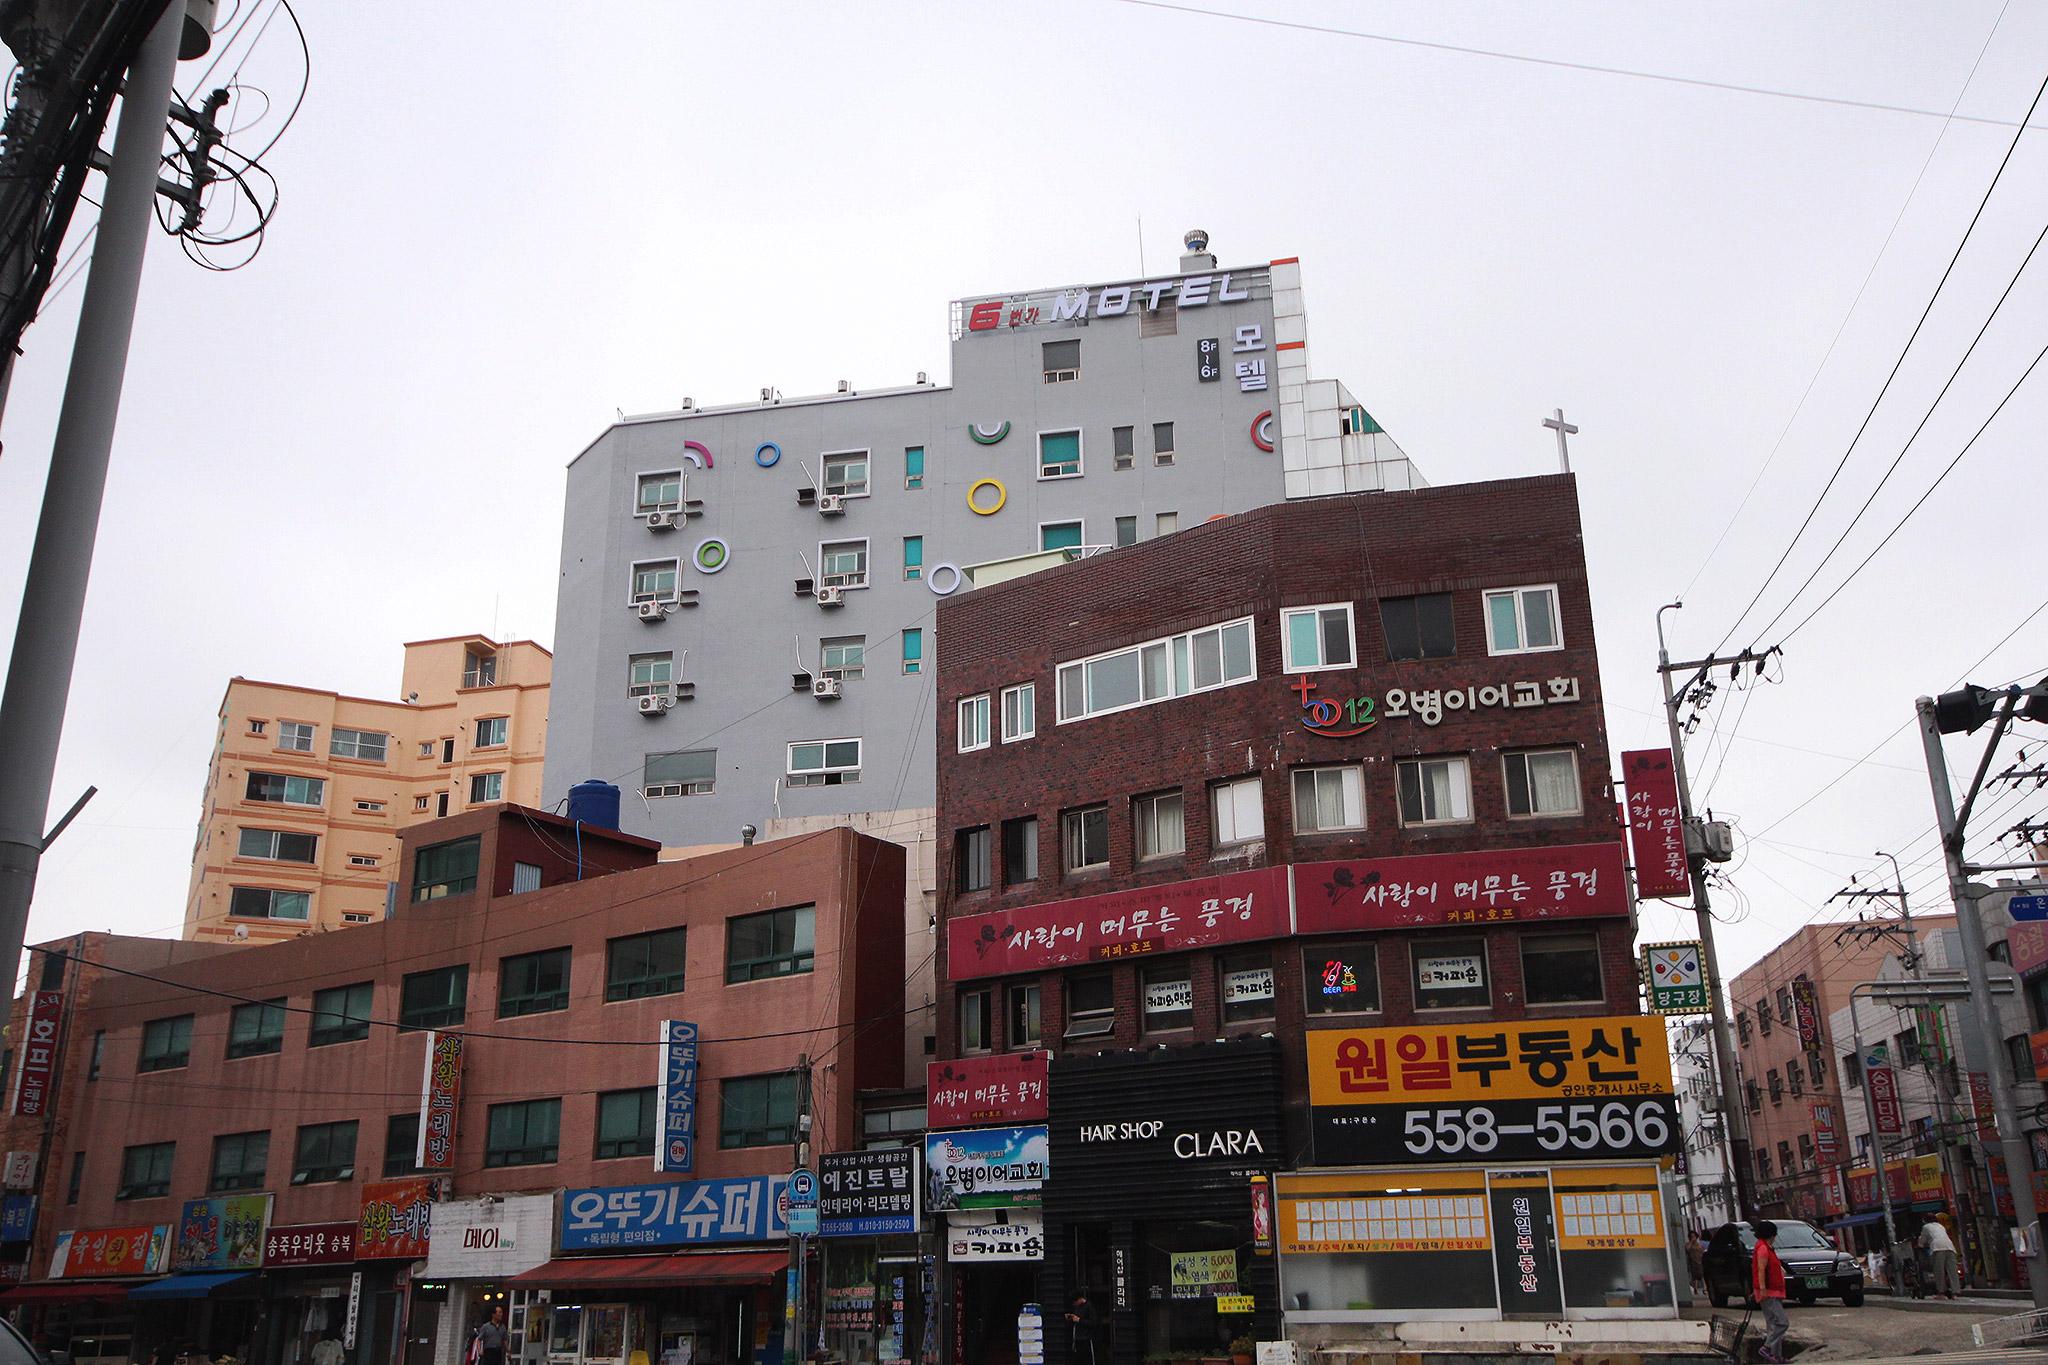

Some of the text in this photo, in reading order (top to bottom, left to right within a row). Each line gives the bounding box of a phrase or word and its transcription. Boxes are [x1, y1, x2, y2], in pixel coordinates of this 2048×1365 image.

[1050, 274, 1248, 322] MOTEL
[1200, 339, 1217, 353] 8F
[1233, 323, 1268, 392] 모텔
[1201, 365, 1218, 379] 6F
[1384, 676, 1581, 727] 오병이어교회
[1631, 791, 1652, 832] 사랑이
[1362, 867, 1598, 908] 사랑이 머무는 풍경
[1007, 921, 1085, 951] 사랑이
[1100, 905, 1181, 939] 머무는
[1197, 892, 1254, 929] 풍경
[1236, 978, 1273, 995] 커피숍
[1433, 966, 1478, 983] 커피숍
[1323, 986, 1341, 994] BEER
[1657, 990, 1702, 1008] 당구장
[27, 1018, 56, 1072] 호프
[1335, 1026, 1642, 1093] 원일부동산
[667, 1024, 696, 1132] 오뚜기슈퍼
[1561, 1081, 1664, 1097] 공인중개사 사무소
[933, 1079, 1042, 1107] 사랑이 머무는 풍경
[1080, 1120, 1164, 1142] HAIR SHOP
[1403, 1100, 1669, 1154] 558-5566
[1173, 1129, 1264, 1159] CLARA
[823, 1166, 909, 1192] 예진토탈
[943, 1161, 1043, 1192] 오병이어교회
[568, 1180, 761, 1239] 오뚜기슈퍼
[463, 1227, 515, 1250] 메이 May
[624, 1230, 655, 1243] 편의점
[966, 1227, 990, 1237] 사랑이
[992, 1225, 1012, 1236] 머무는
[1512, 1197, 1538, 1292] 원일부동산
[1586, 1238, 1635, 1248] 재개발상담
[268, 1232, 351, 1258] 송죽우리옷 승복
[971, 1236, 1043, 1257] 커피숍
